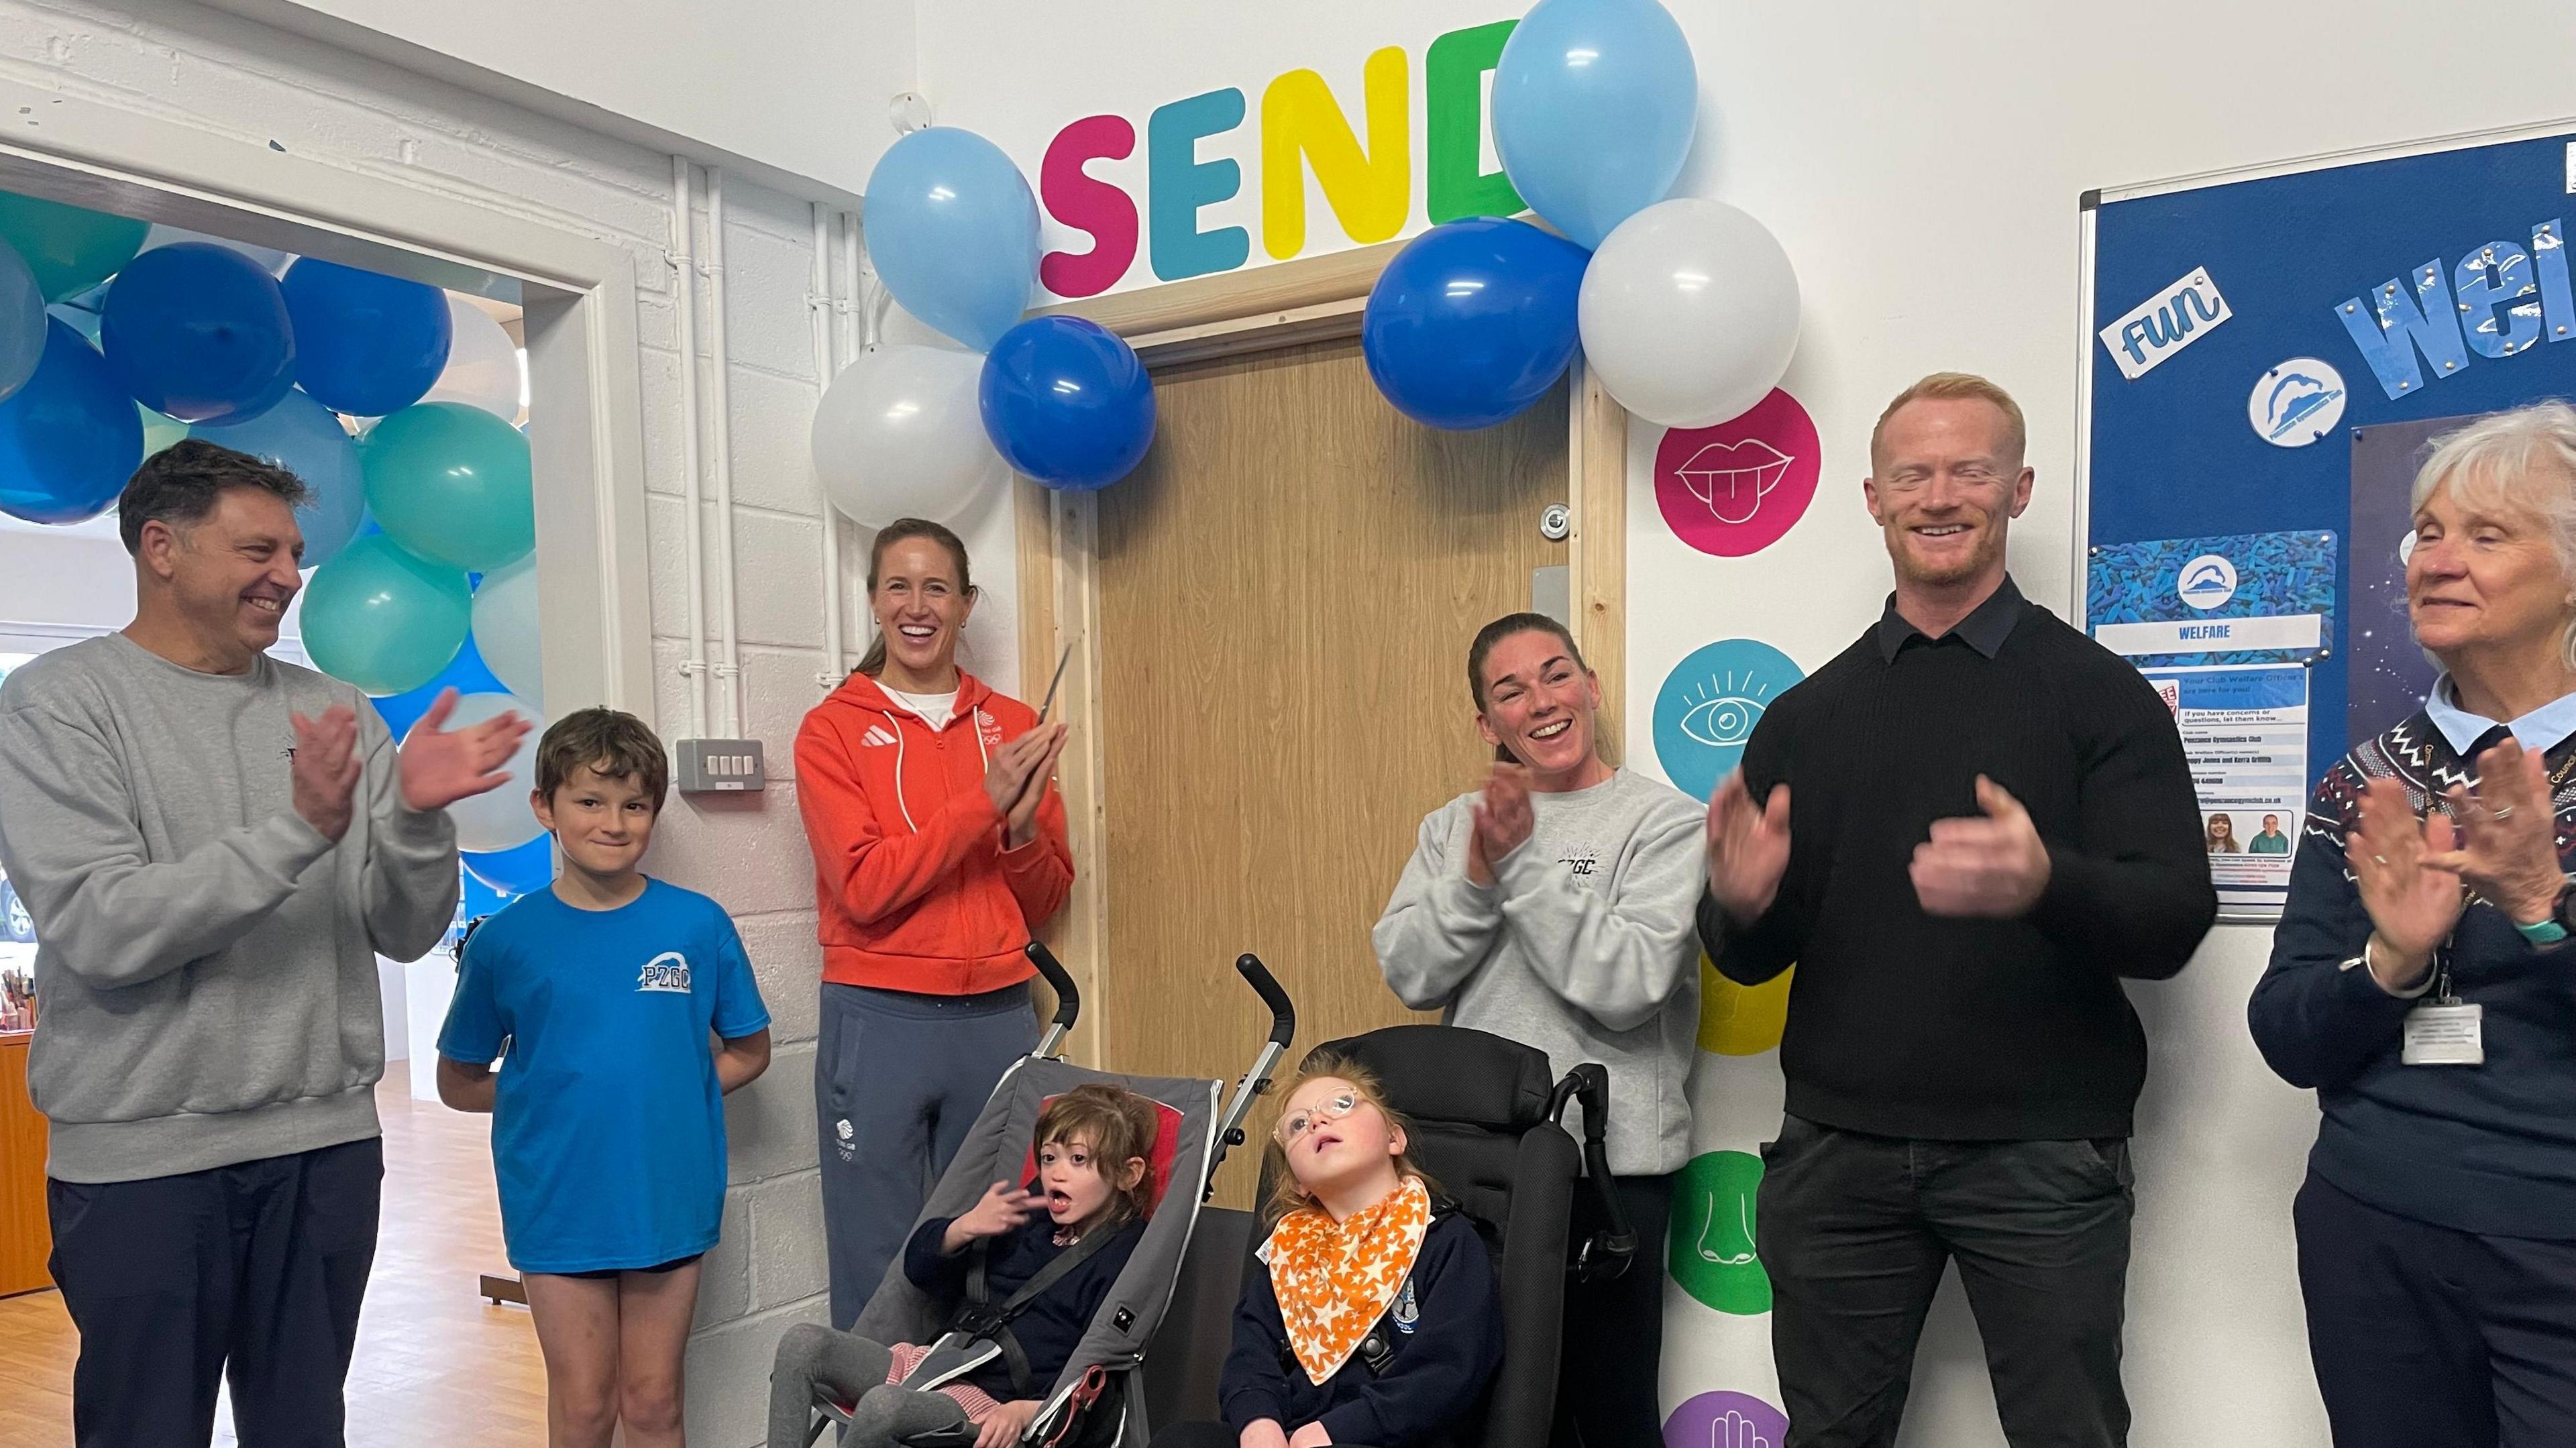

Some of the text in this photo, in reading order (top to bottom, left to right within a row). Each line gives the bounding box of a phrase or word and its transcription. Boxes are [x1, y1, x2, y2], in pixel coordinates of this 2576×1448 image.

[1040, 19, 1530, 298] SEND
[2180, 624, 2231, 640] WELFARE
[642, 965, 690, 989] PZGC
